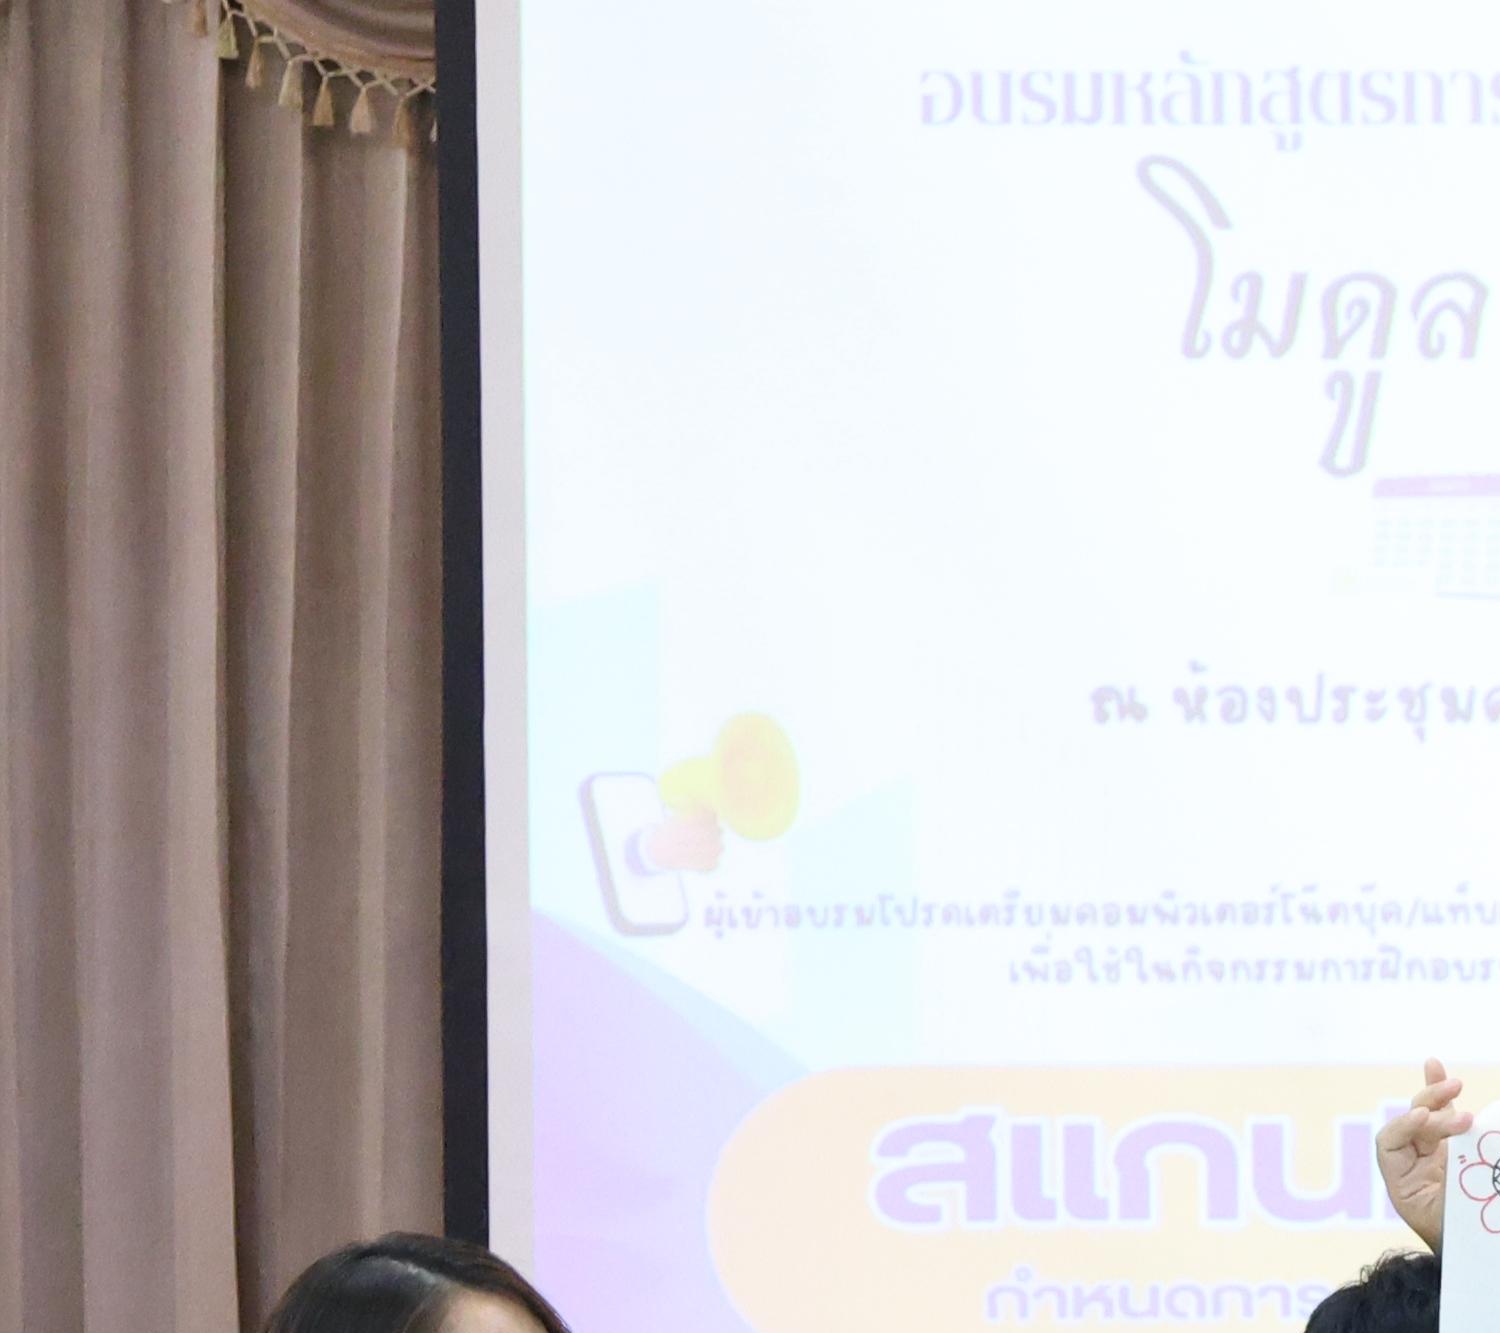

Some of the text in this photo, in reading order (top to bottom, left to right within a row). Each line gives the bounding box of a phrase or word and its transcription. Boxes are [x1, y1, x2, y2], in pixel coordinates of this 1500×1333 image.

[1135, 155, 1493, 478] โมดูล
[1089, 680, 1149, 727] ณ
[873, 1112, 1420, 1224] สแกน
